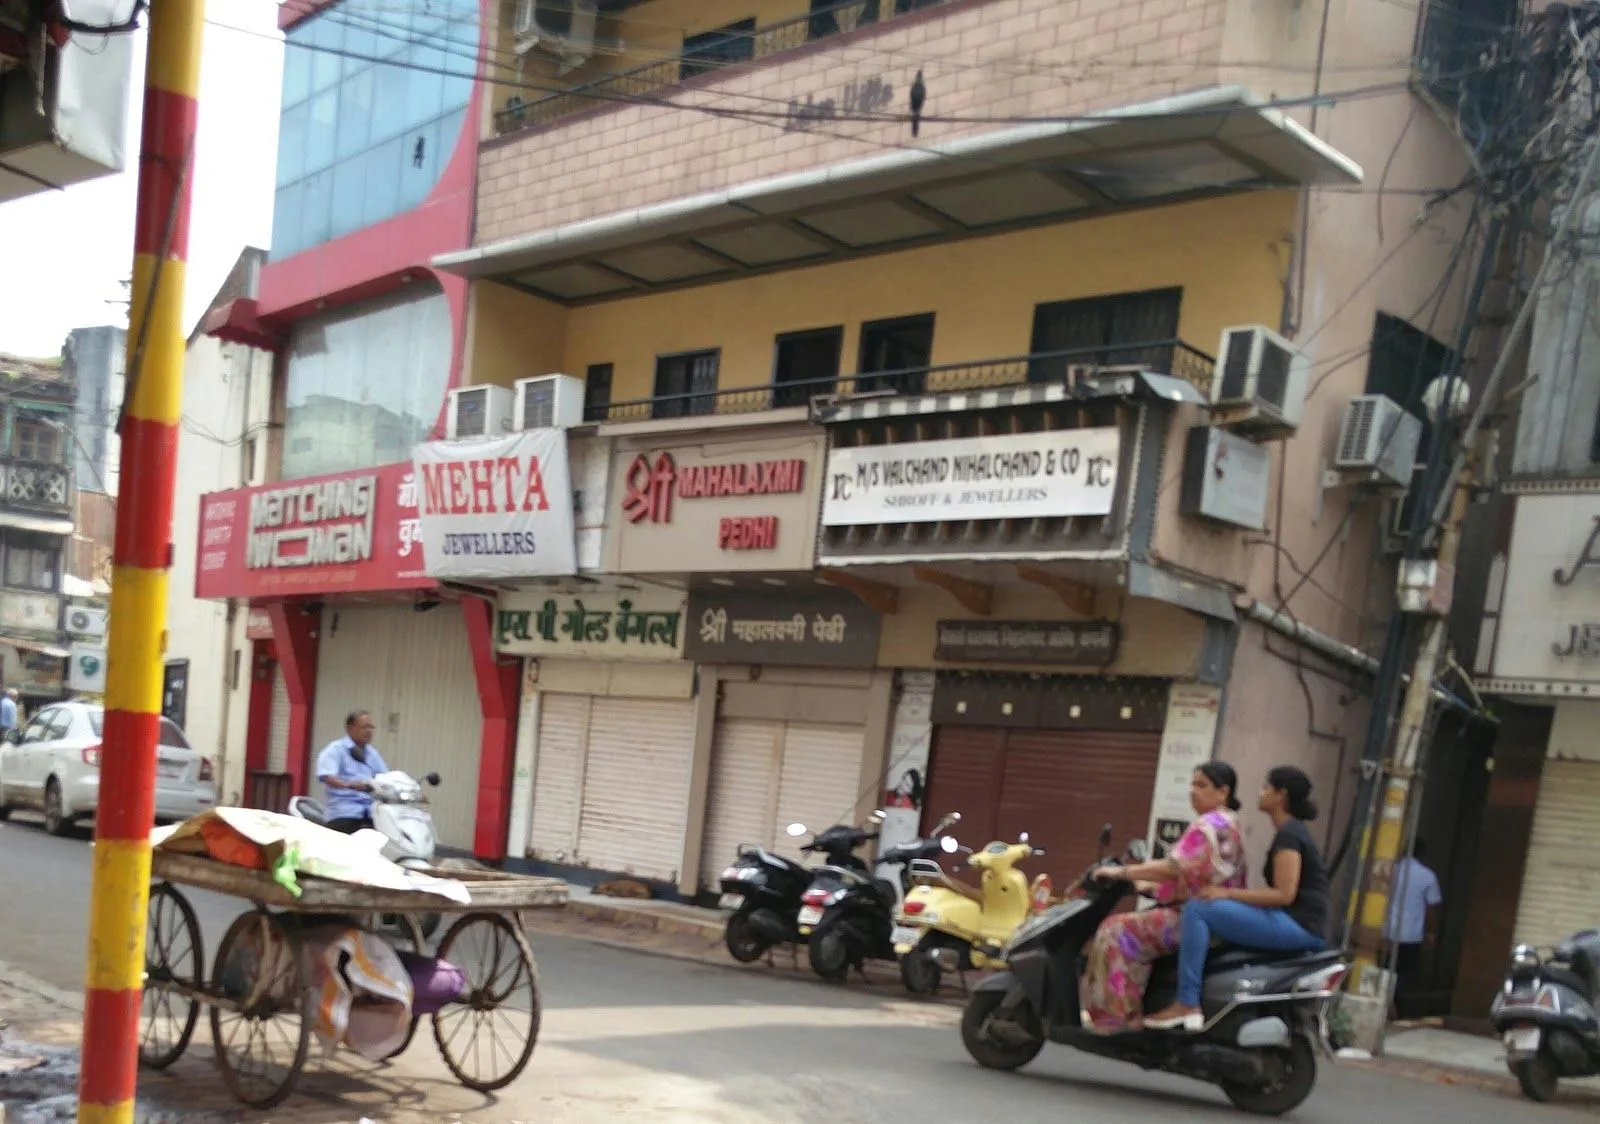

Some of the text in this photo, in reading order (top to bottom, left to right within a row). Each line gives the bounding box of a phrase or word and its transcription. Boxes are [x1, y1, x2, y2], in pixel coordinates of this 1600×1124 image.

[421, 455, 550, 515] MEHTA
[679, 459, 805, 499] MAHALAXMI
[882, 455, 949, 486] VALCHAND
[951, 449, 1042, 484] NIHALCHAND
[1045, 448, 1057, 475] &
[622, 451, 678, 524] श्री
[958, 486, 1049, 505] JEWELLERS
[442, 531, 537, 556] JEWELLERS
[718, 515, 779, 550] PEDHI
[699, 607, 728, 644] श्री
